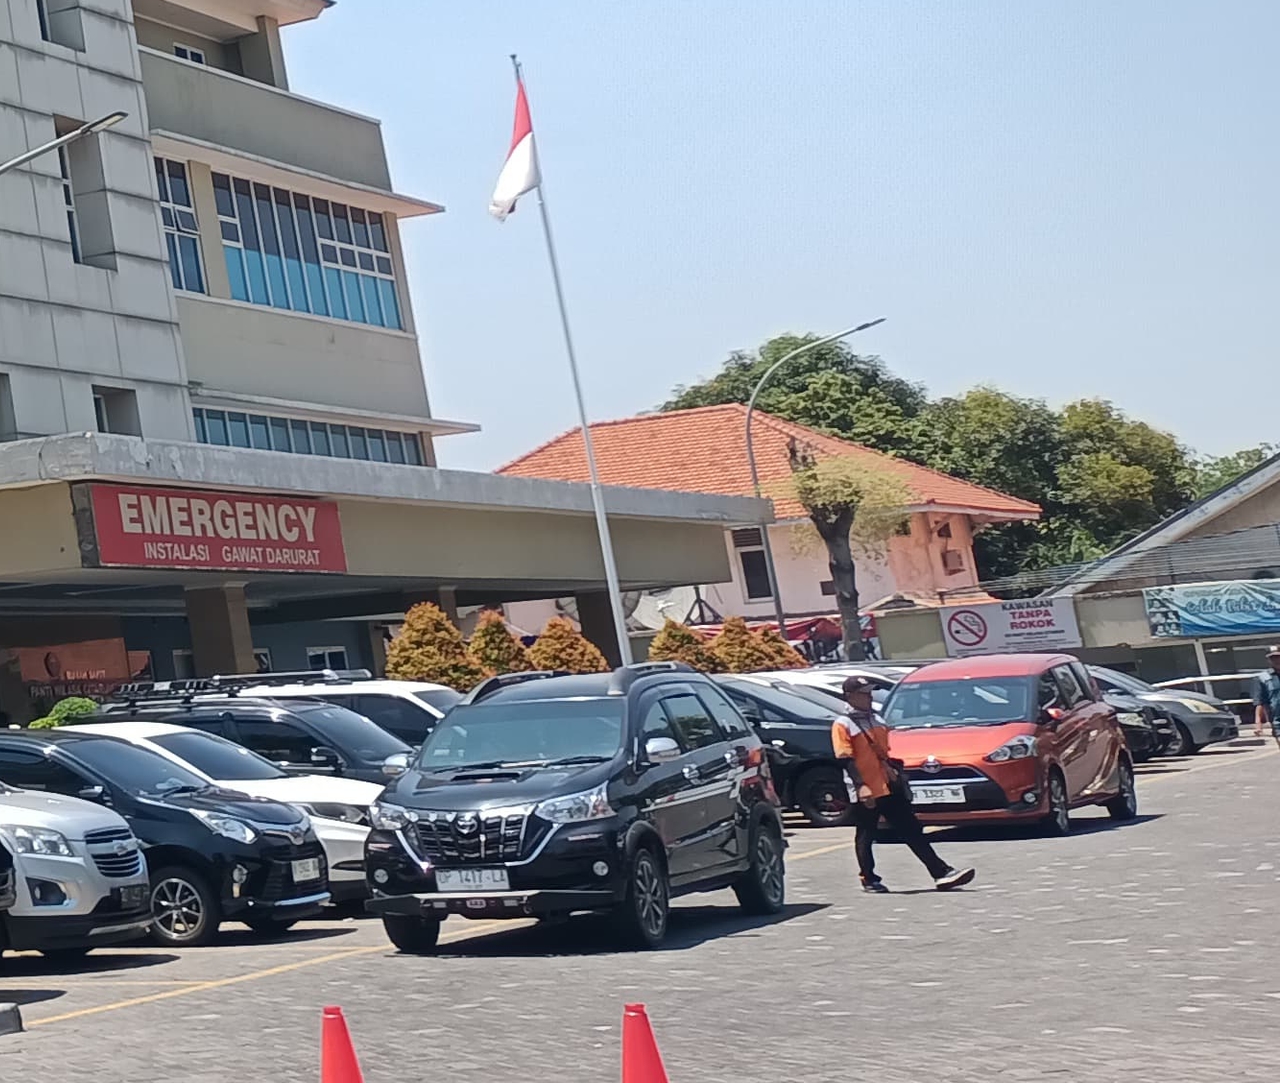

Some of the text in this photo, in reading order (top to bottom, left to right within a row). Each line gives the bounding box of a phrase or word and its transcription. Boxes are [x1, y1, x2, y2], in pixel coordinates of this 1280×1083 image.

[118, 493, 316, 542] EMERGENCY
[144, 542, 320, 566] INSTALASI GAWAT DARURAT
[1001, 600, 1054, 611] KAWASAN
[1009, 609, 1052, 620] TANPA
[1010, 619, 1056, 630] ROKOK
